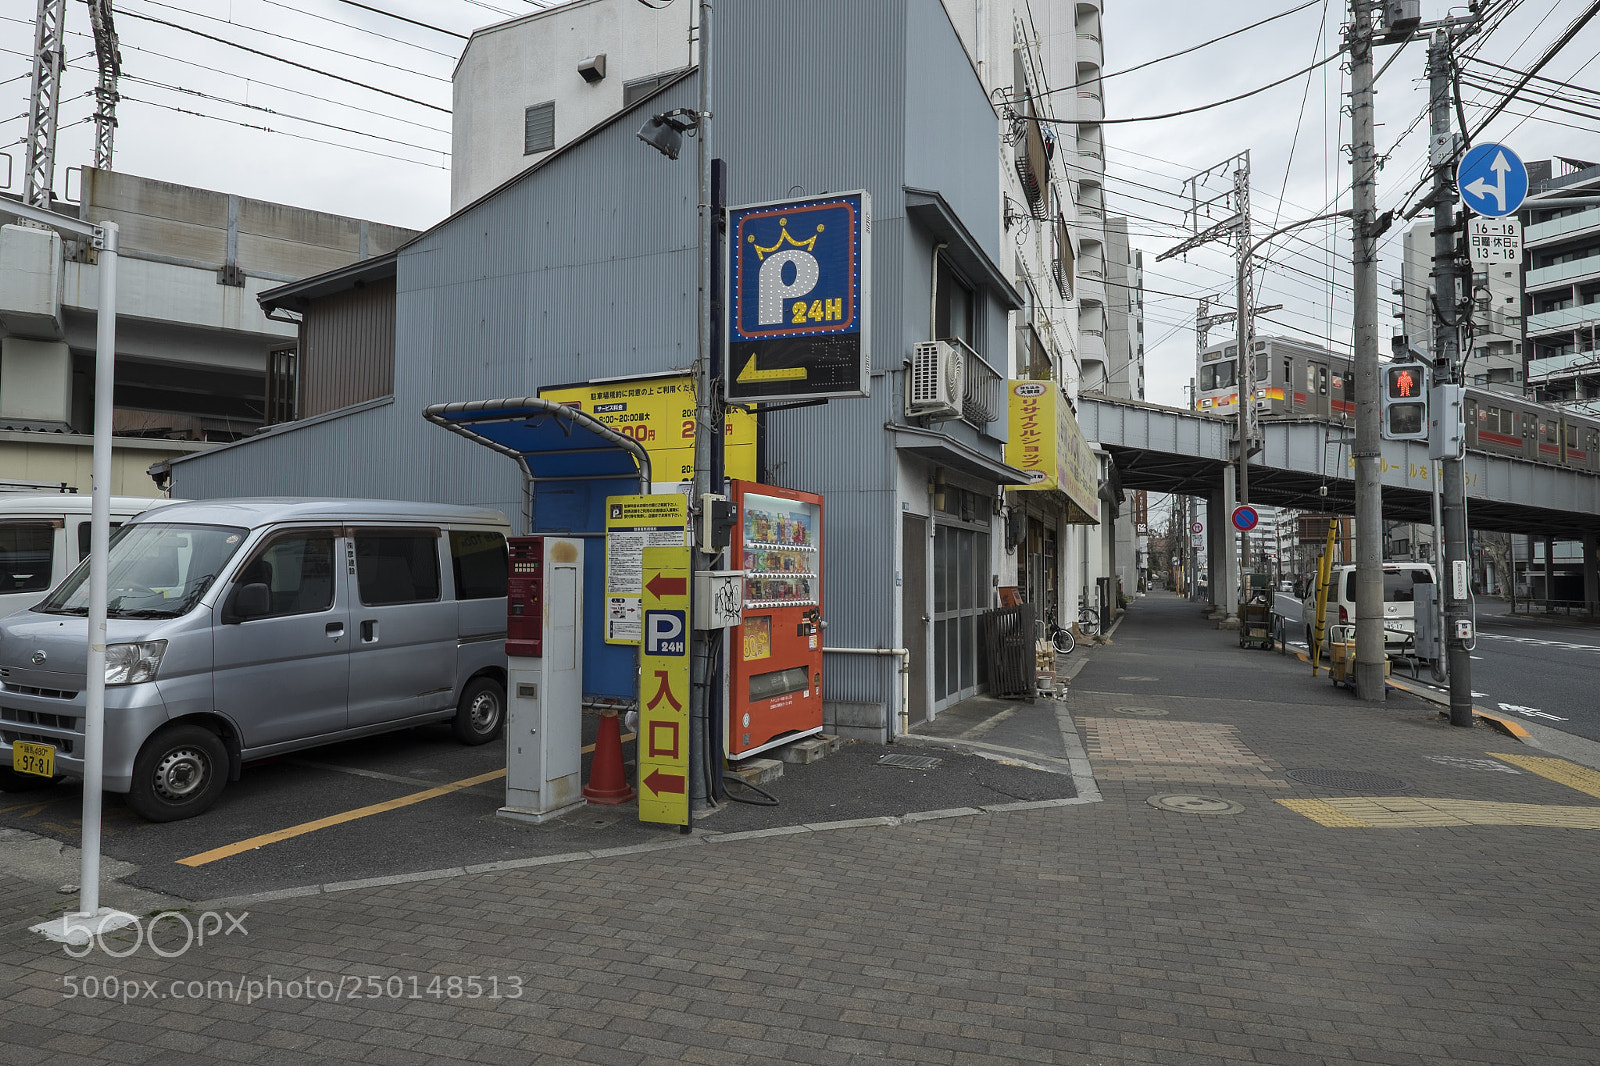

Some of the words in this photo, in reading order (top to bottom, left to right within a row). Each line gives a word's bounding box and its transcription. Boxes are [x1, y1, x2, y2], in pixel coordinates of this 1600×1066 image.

[758, 249, 820, 326] P
[791, 297, 842, 324] 24H
[1019, 398, 1043, 468] リサイクルショップ
[648, 613, 682, 652] P
[661, 641, 684, 652] 24H
[646, 670, 683, 760] 入口
[22, 755, 50, 775] 97-81
